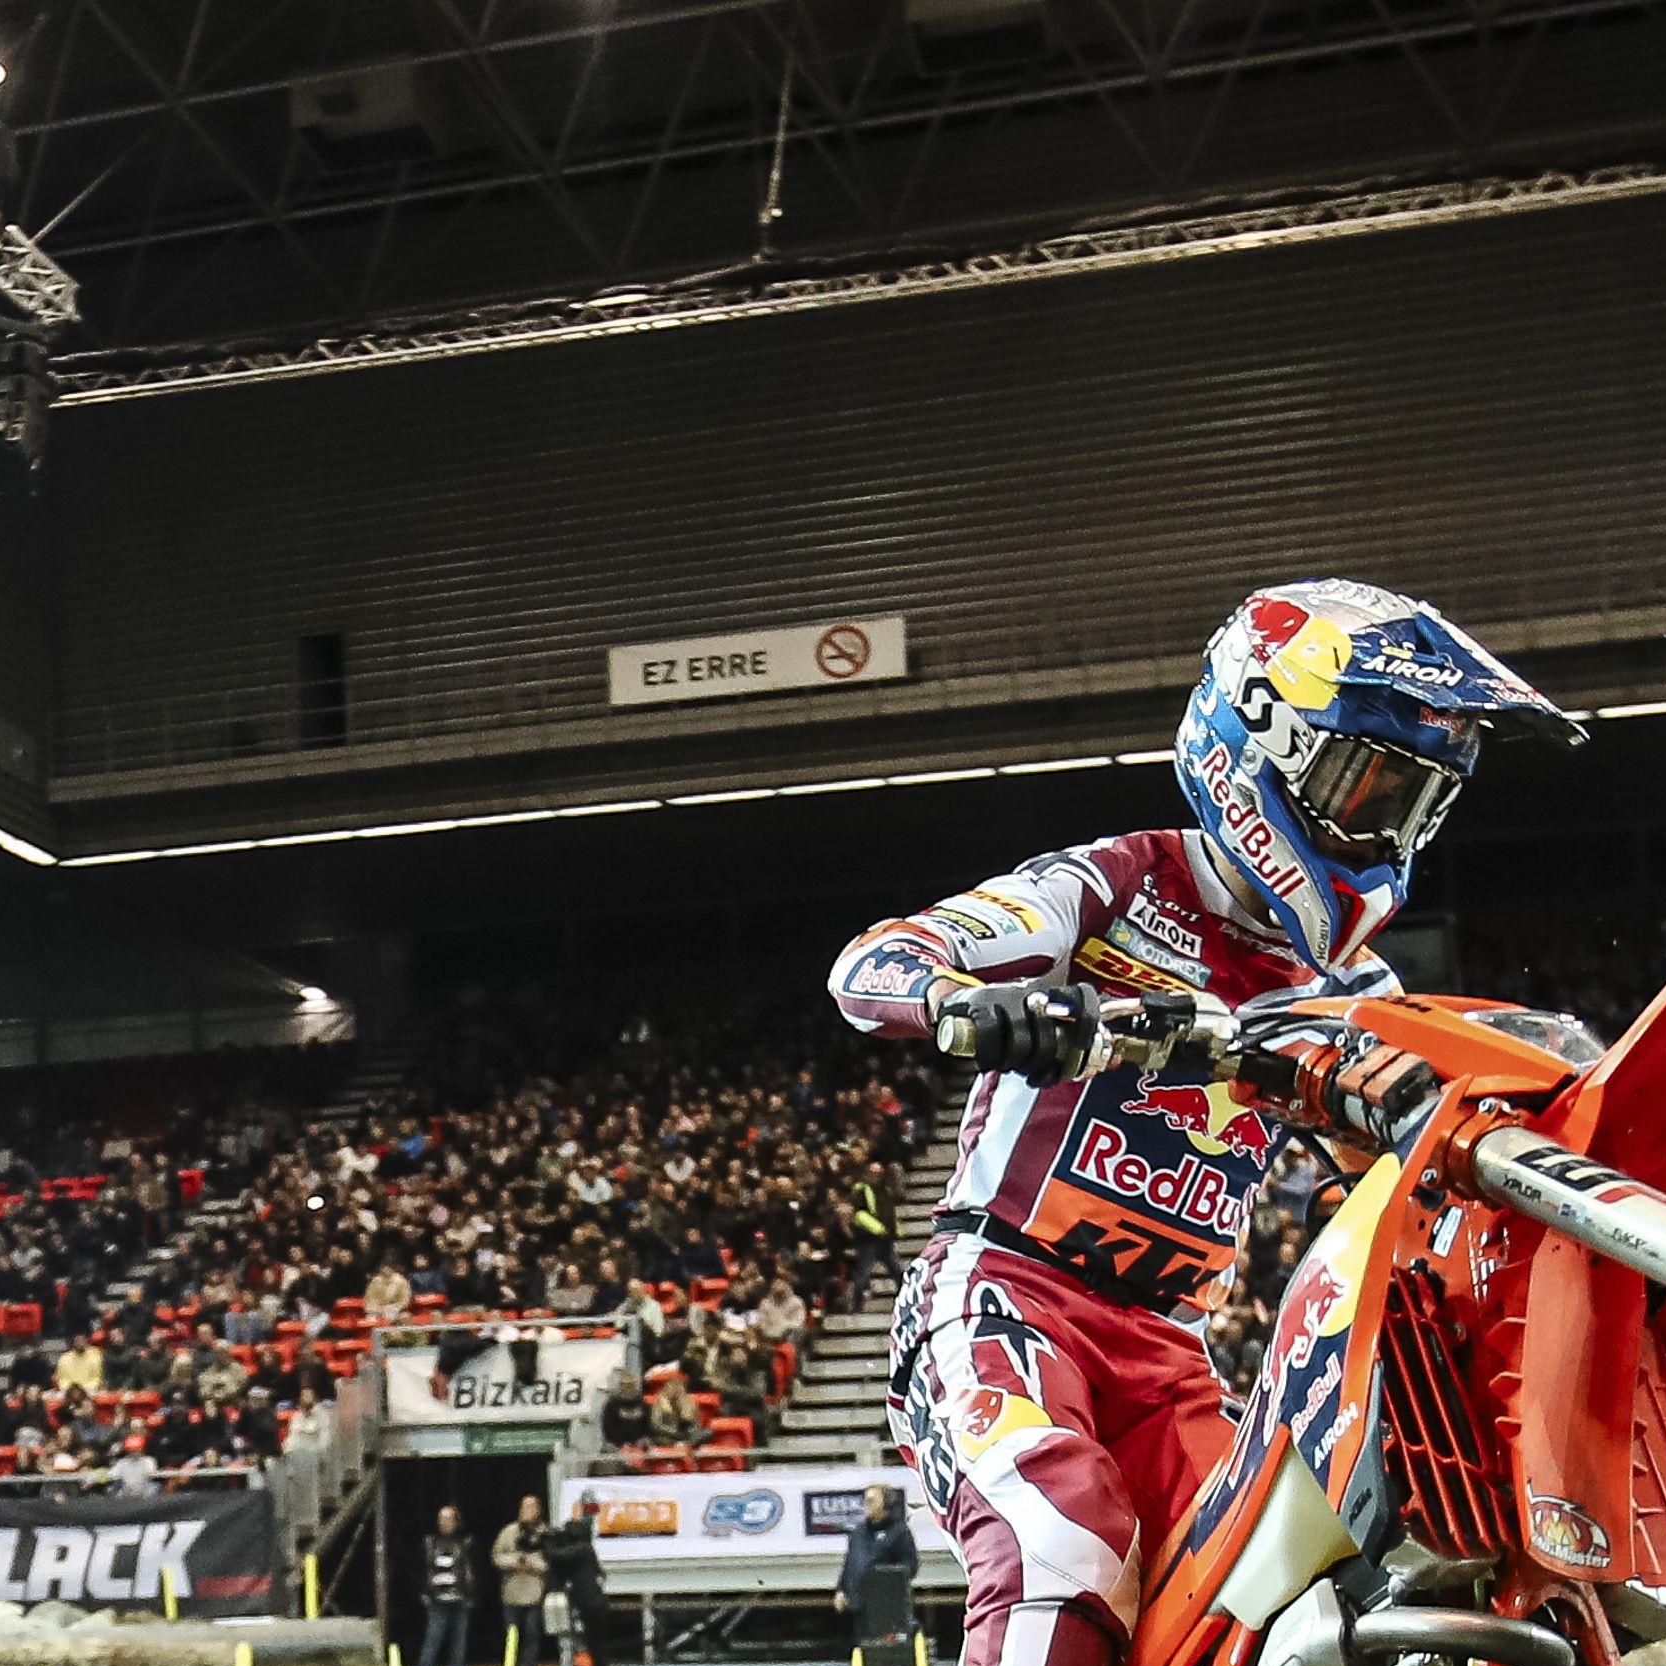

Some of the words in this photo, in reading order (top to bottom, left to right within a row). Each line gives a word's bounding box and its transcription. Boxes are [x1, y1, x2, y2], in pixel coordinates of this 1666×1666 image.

[641, 659, 678, 687] EZ
[688, 651, 769, 681] ERRE
[1361, 654, 1465, 688] AIROH
[1133, 903, 1197, 954] AIROH
[453, 1371, 583, 1409] Bizkaia
[1313, 1402, 1359, 1470] AIROH
